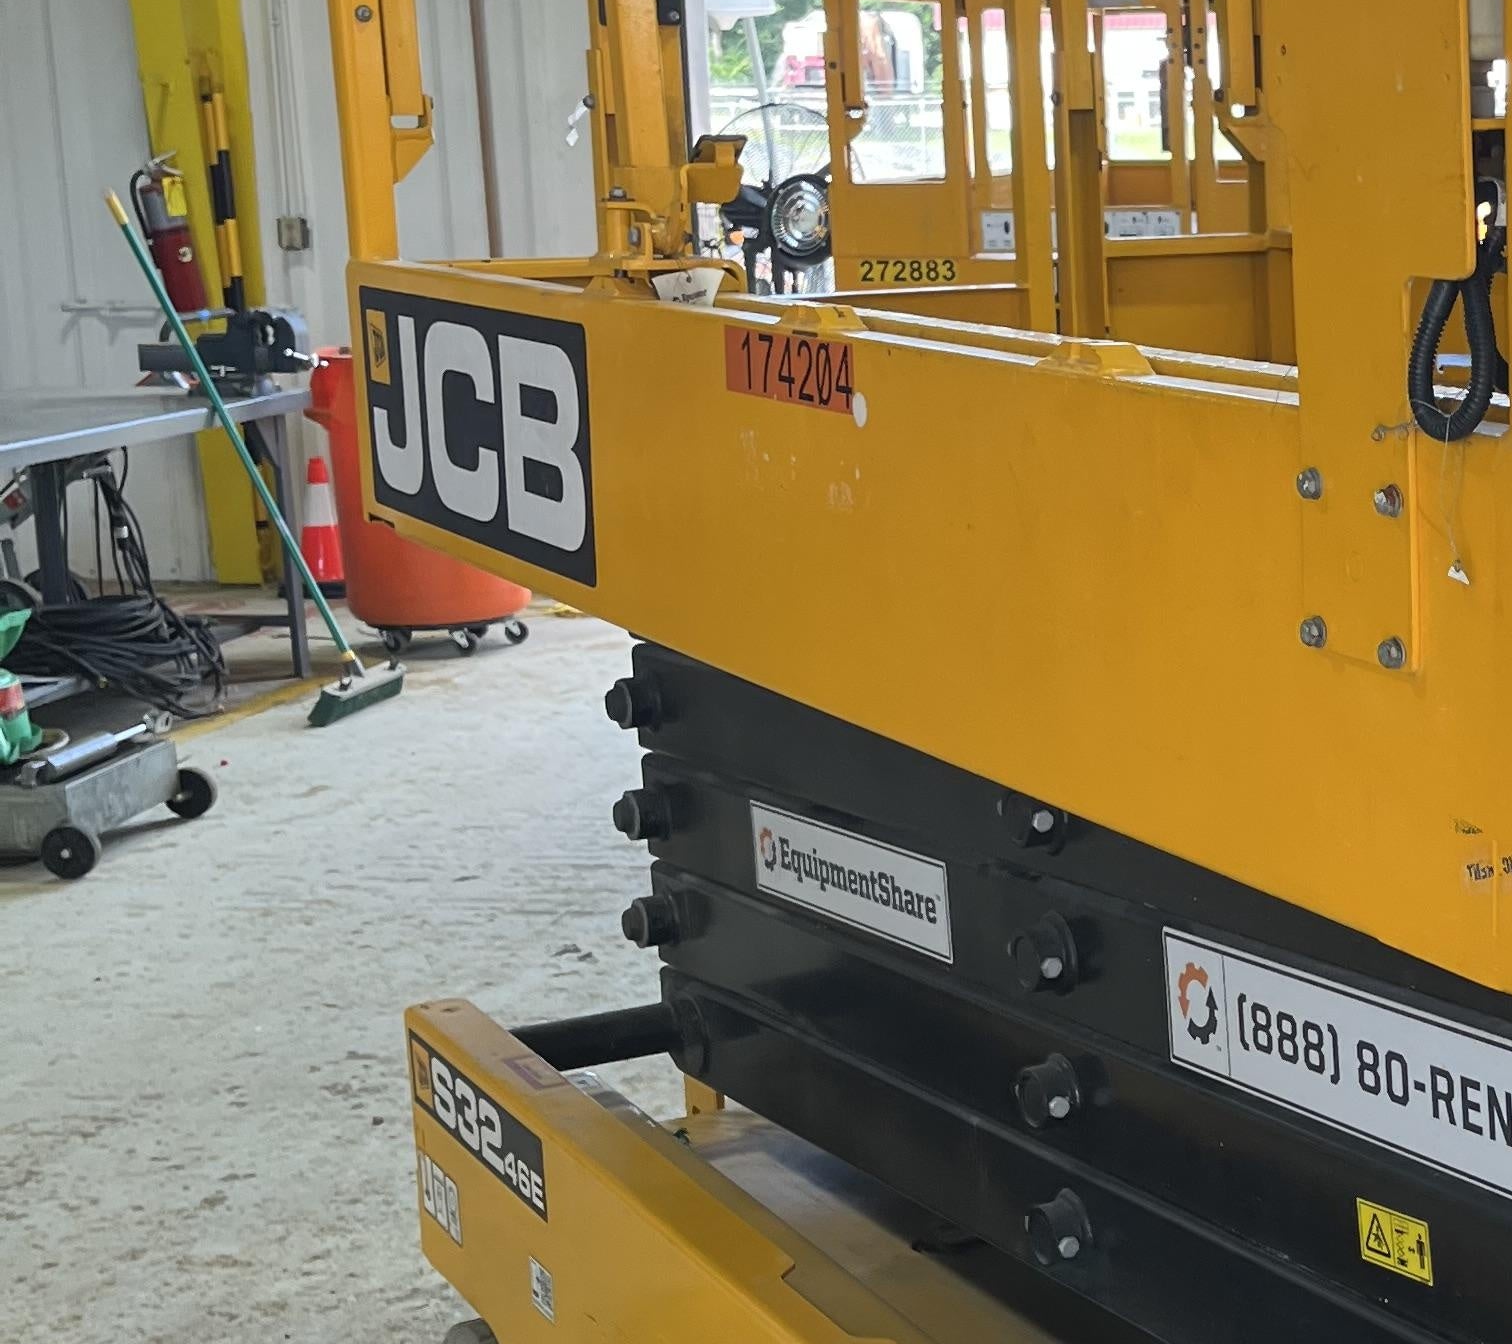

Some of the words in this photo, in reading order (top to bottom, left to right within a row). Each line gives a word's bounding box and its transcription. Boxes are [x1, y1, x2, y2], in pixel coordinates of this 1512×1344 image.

[859, 259, 957, 282] 272883
[741, 330, 853, 409] 174204
[372, 314, 587, 553] JCB
[1236, 991, 1342, 1086] (888)
